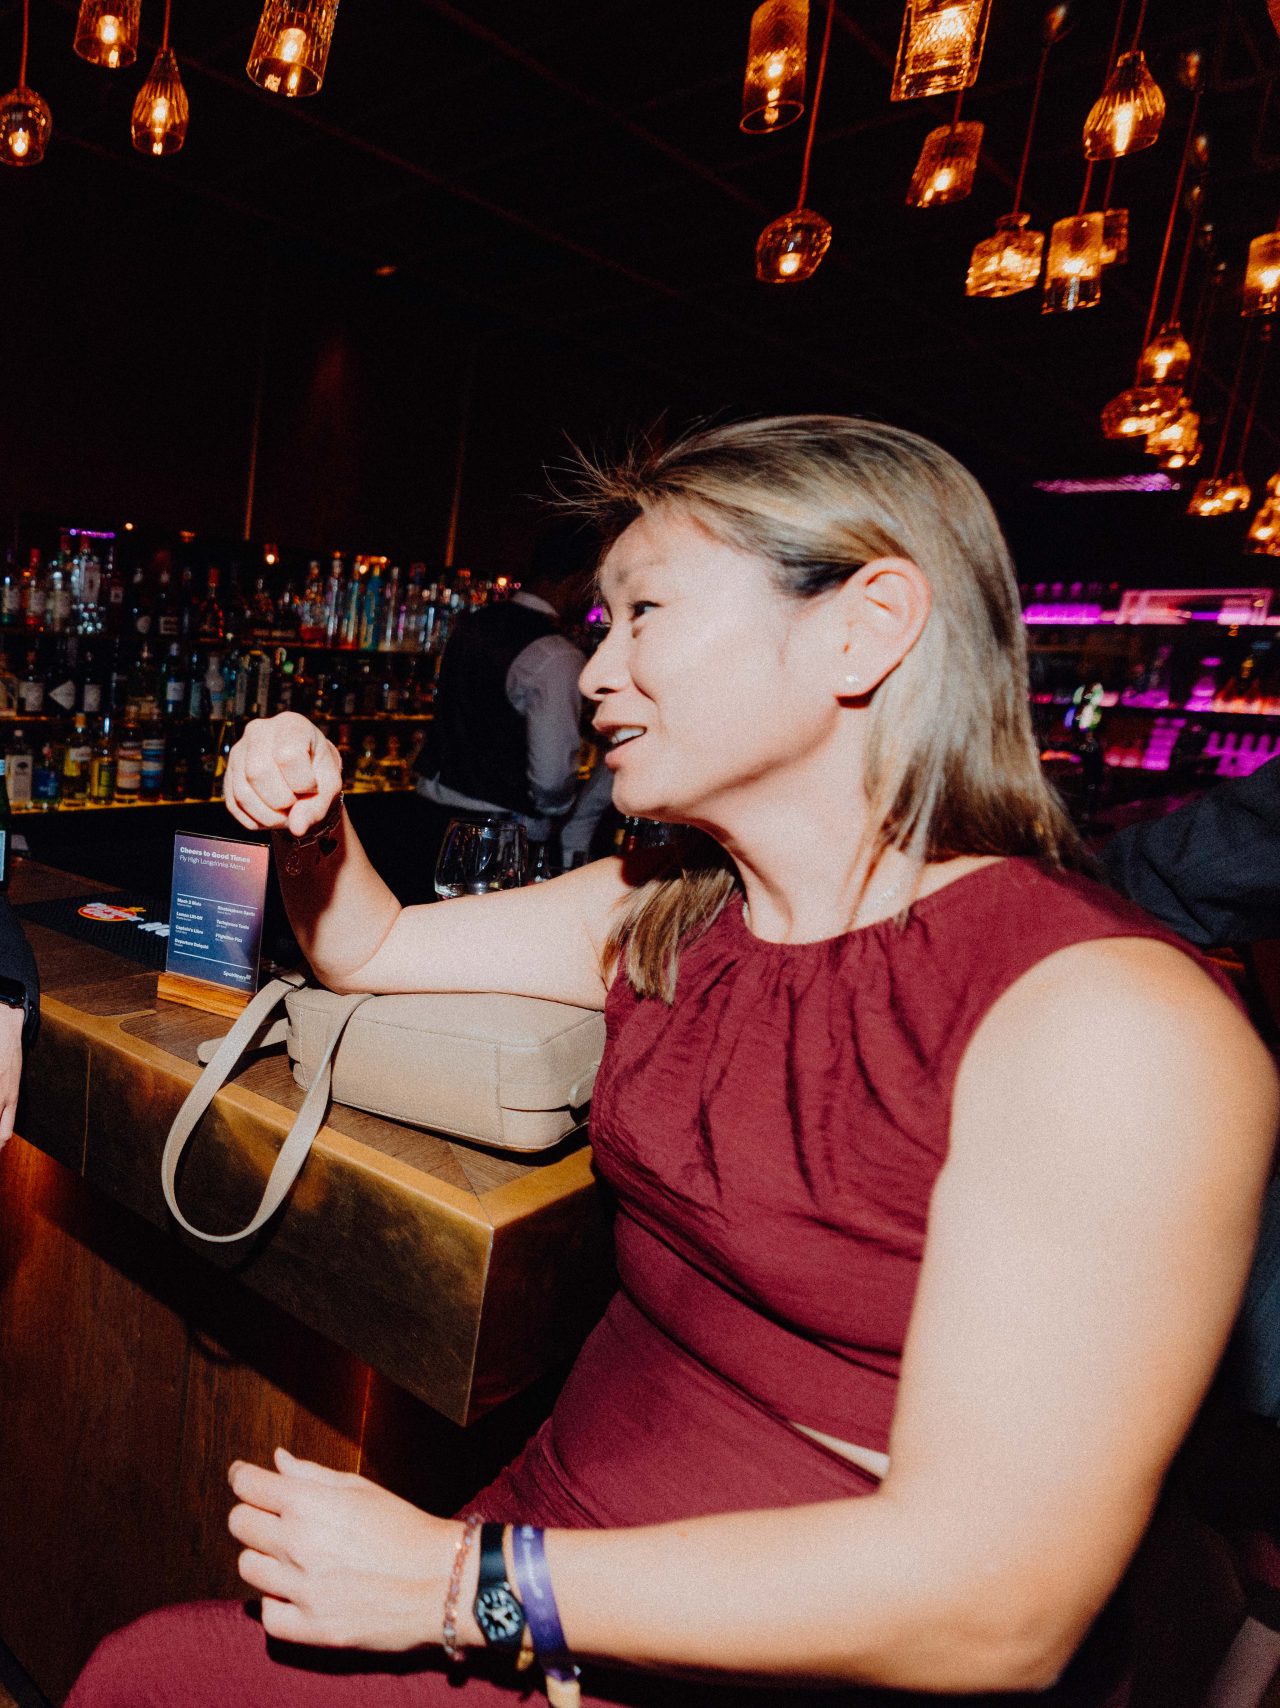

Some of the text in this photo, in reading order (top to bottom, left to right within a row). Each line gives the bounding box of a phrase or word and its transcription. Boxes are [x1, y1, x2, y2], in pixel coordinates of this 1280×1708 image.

[180, 846, 202, 856] Cheers
[211, 851, 229, 860] Good
[230, 855, 251, 863] Times
